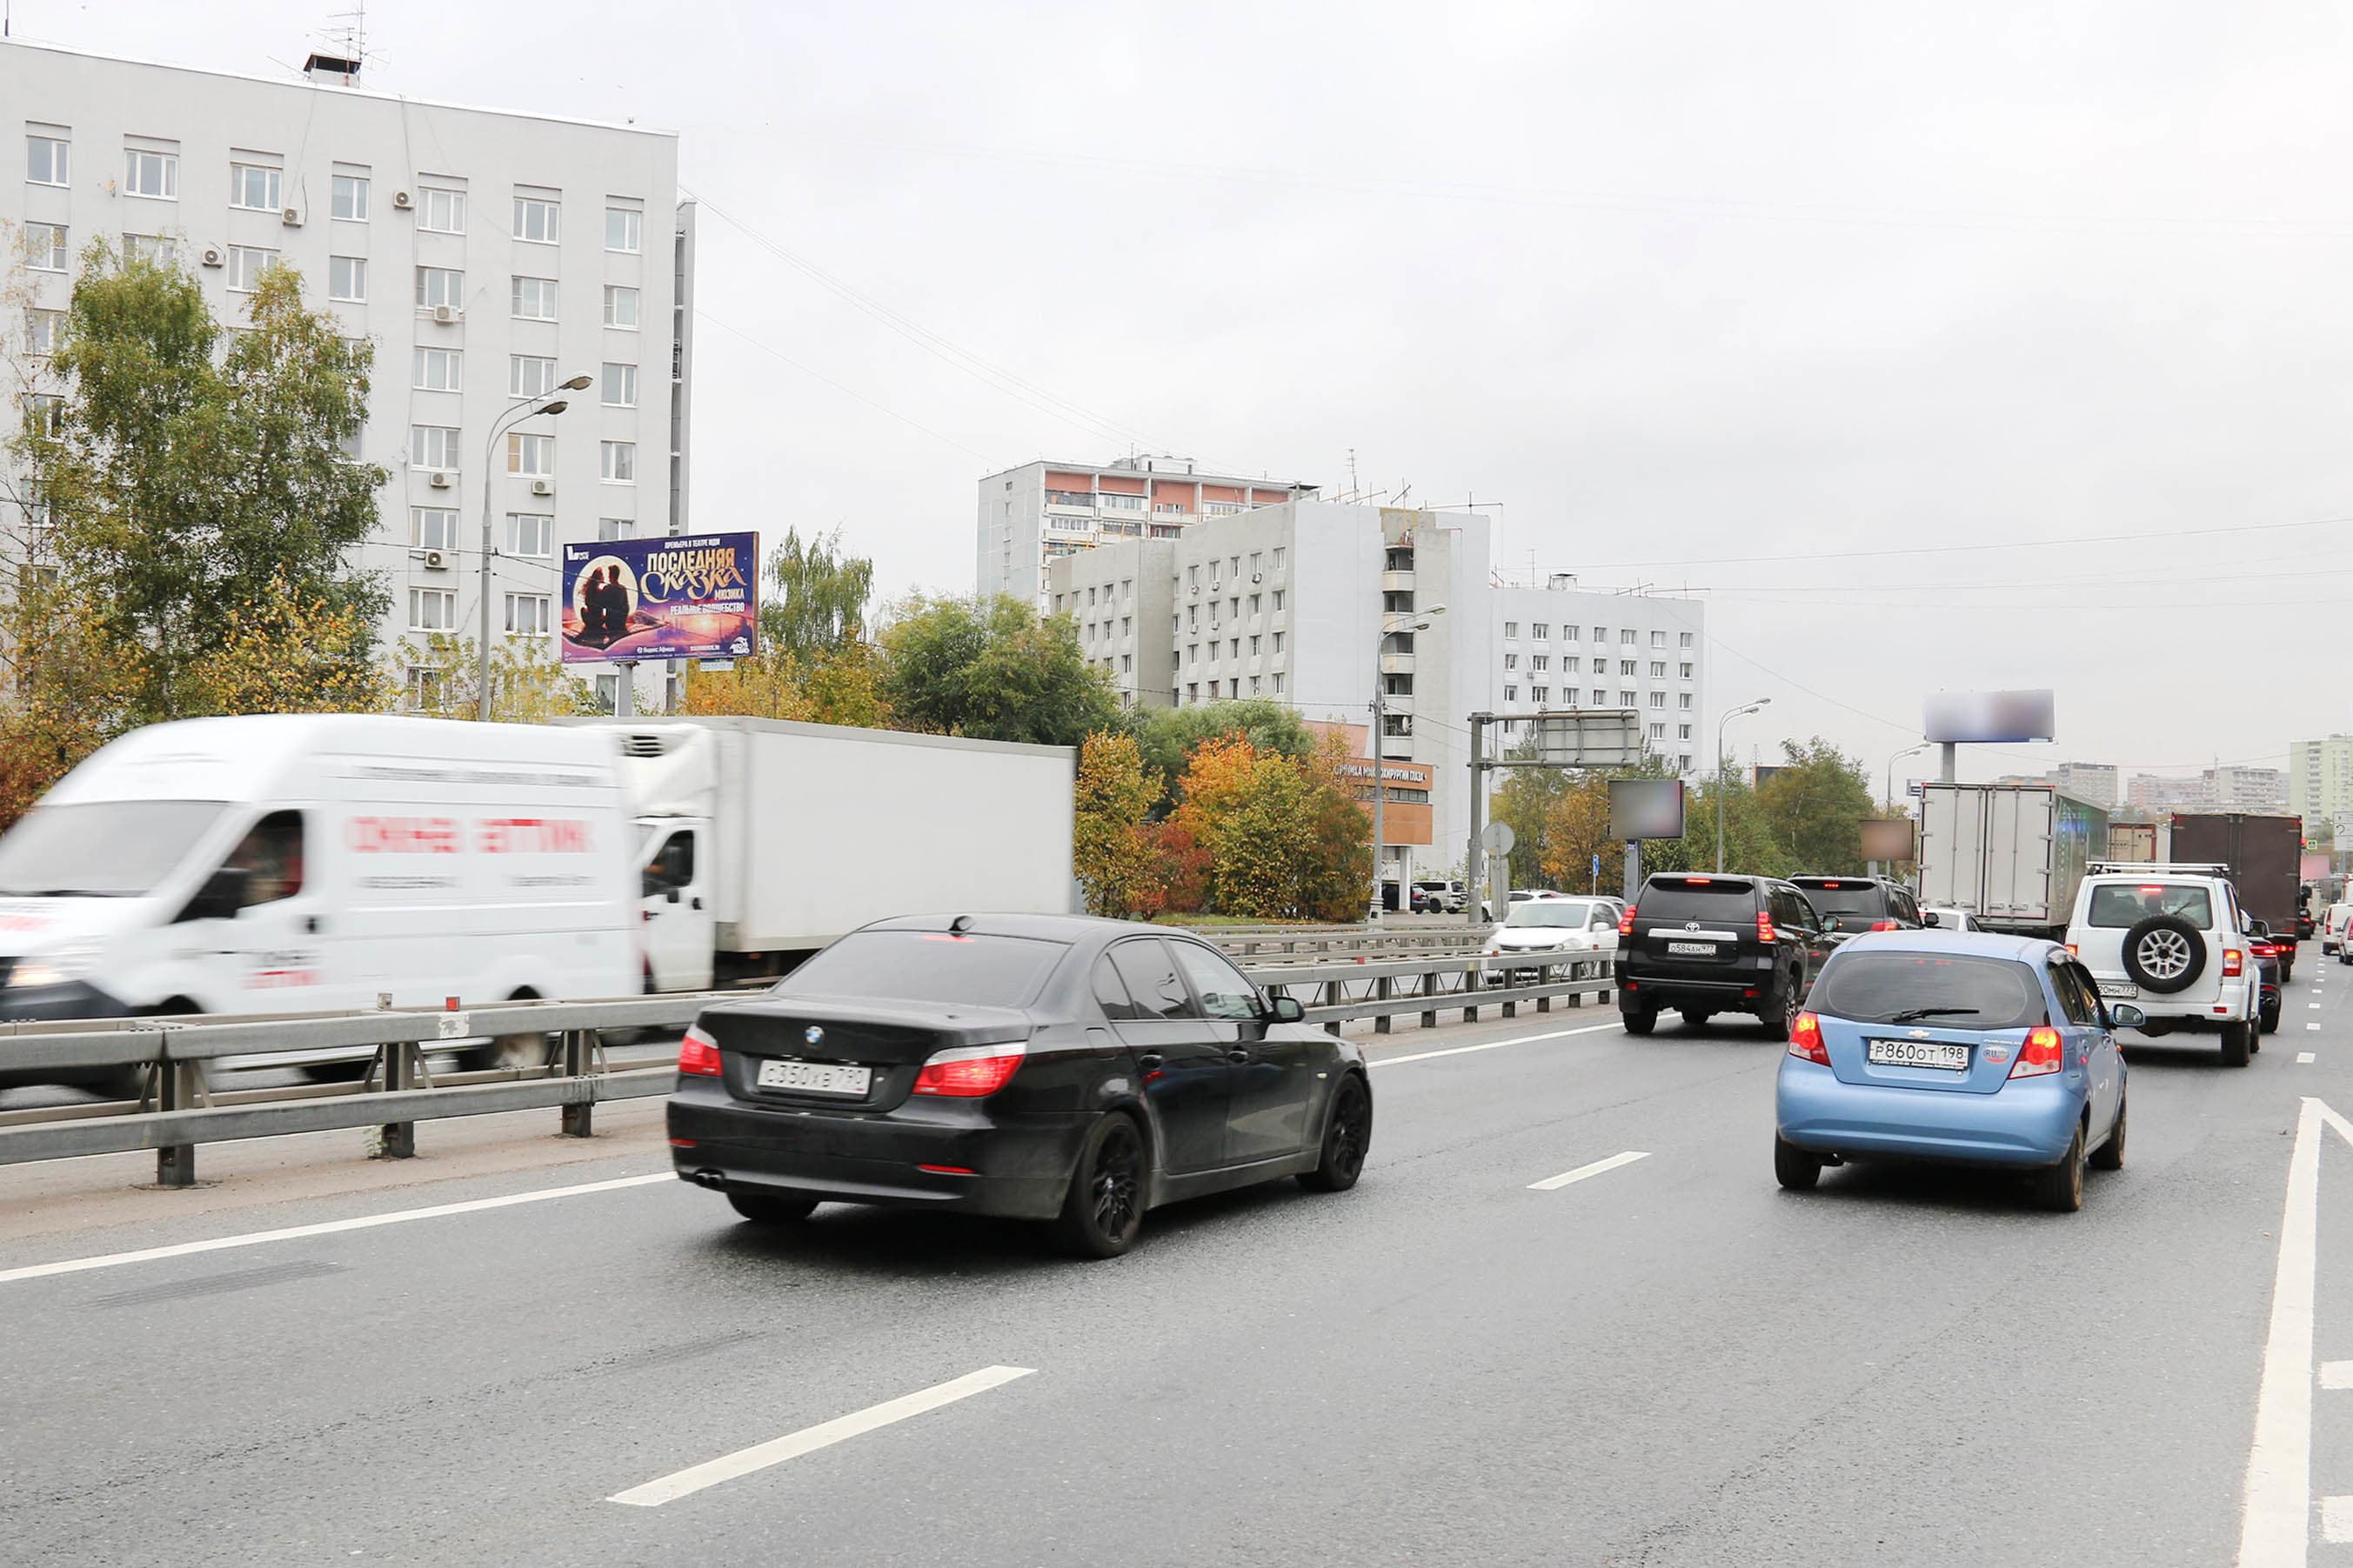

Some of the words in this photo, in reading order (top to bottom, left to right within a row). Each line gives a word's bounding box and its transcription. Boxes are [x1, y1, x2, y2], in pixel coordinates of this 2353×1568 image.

[647, 548, 735, 573] ПОСЛЕДНЯЯ
[1363, 766, 1409, 781] МИКОХИРУРГИИ
[1941, 1046, 1964, 1059] 198
